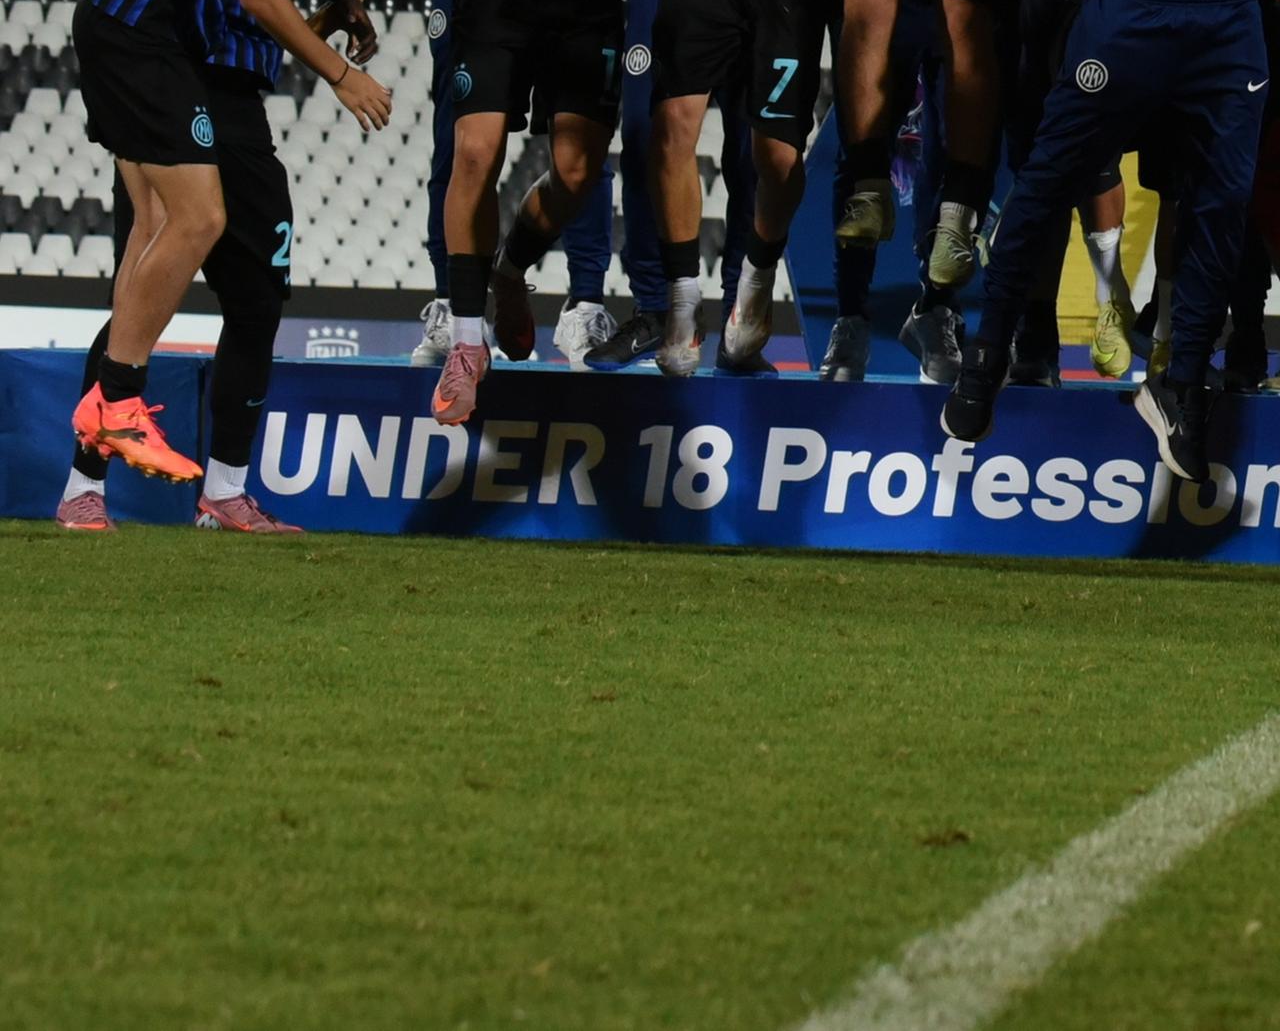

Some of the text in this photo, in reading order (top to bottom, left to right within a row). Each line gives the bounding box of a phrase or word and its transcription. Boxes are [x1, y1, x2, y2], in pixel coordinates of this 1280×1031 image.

[767, 58, 800, 103] 7
[260, 411, 605, 506] UNDER
[638, 424, 734, 511] 18
